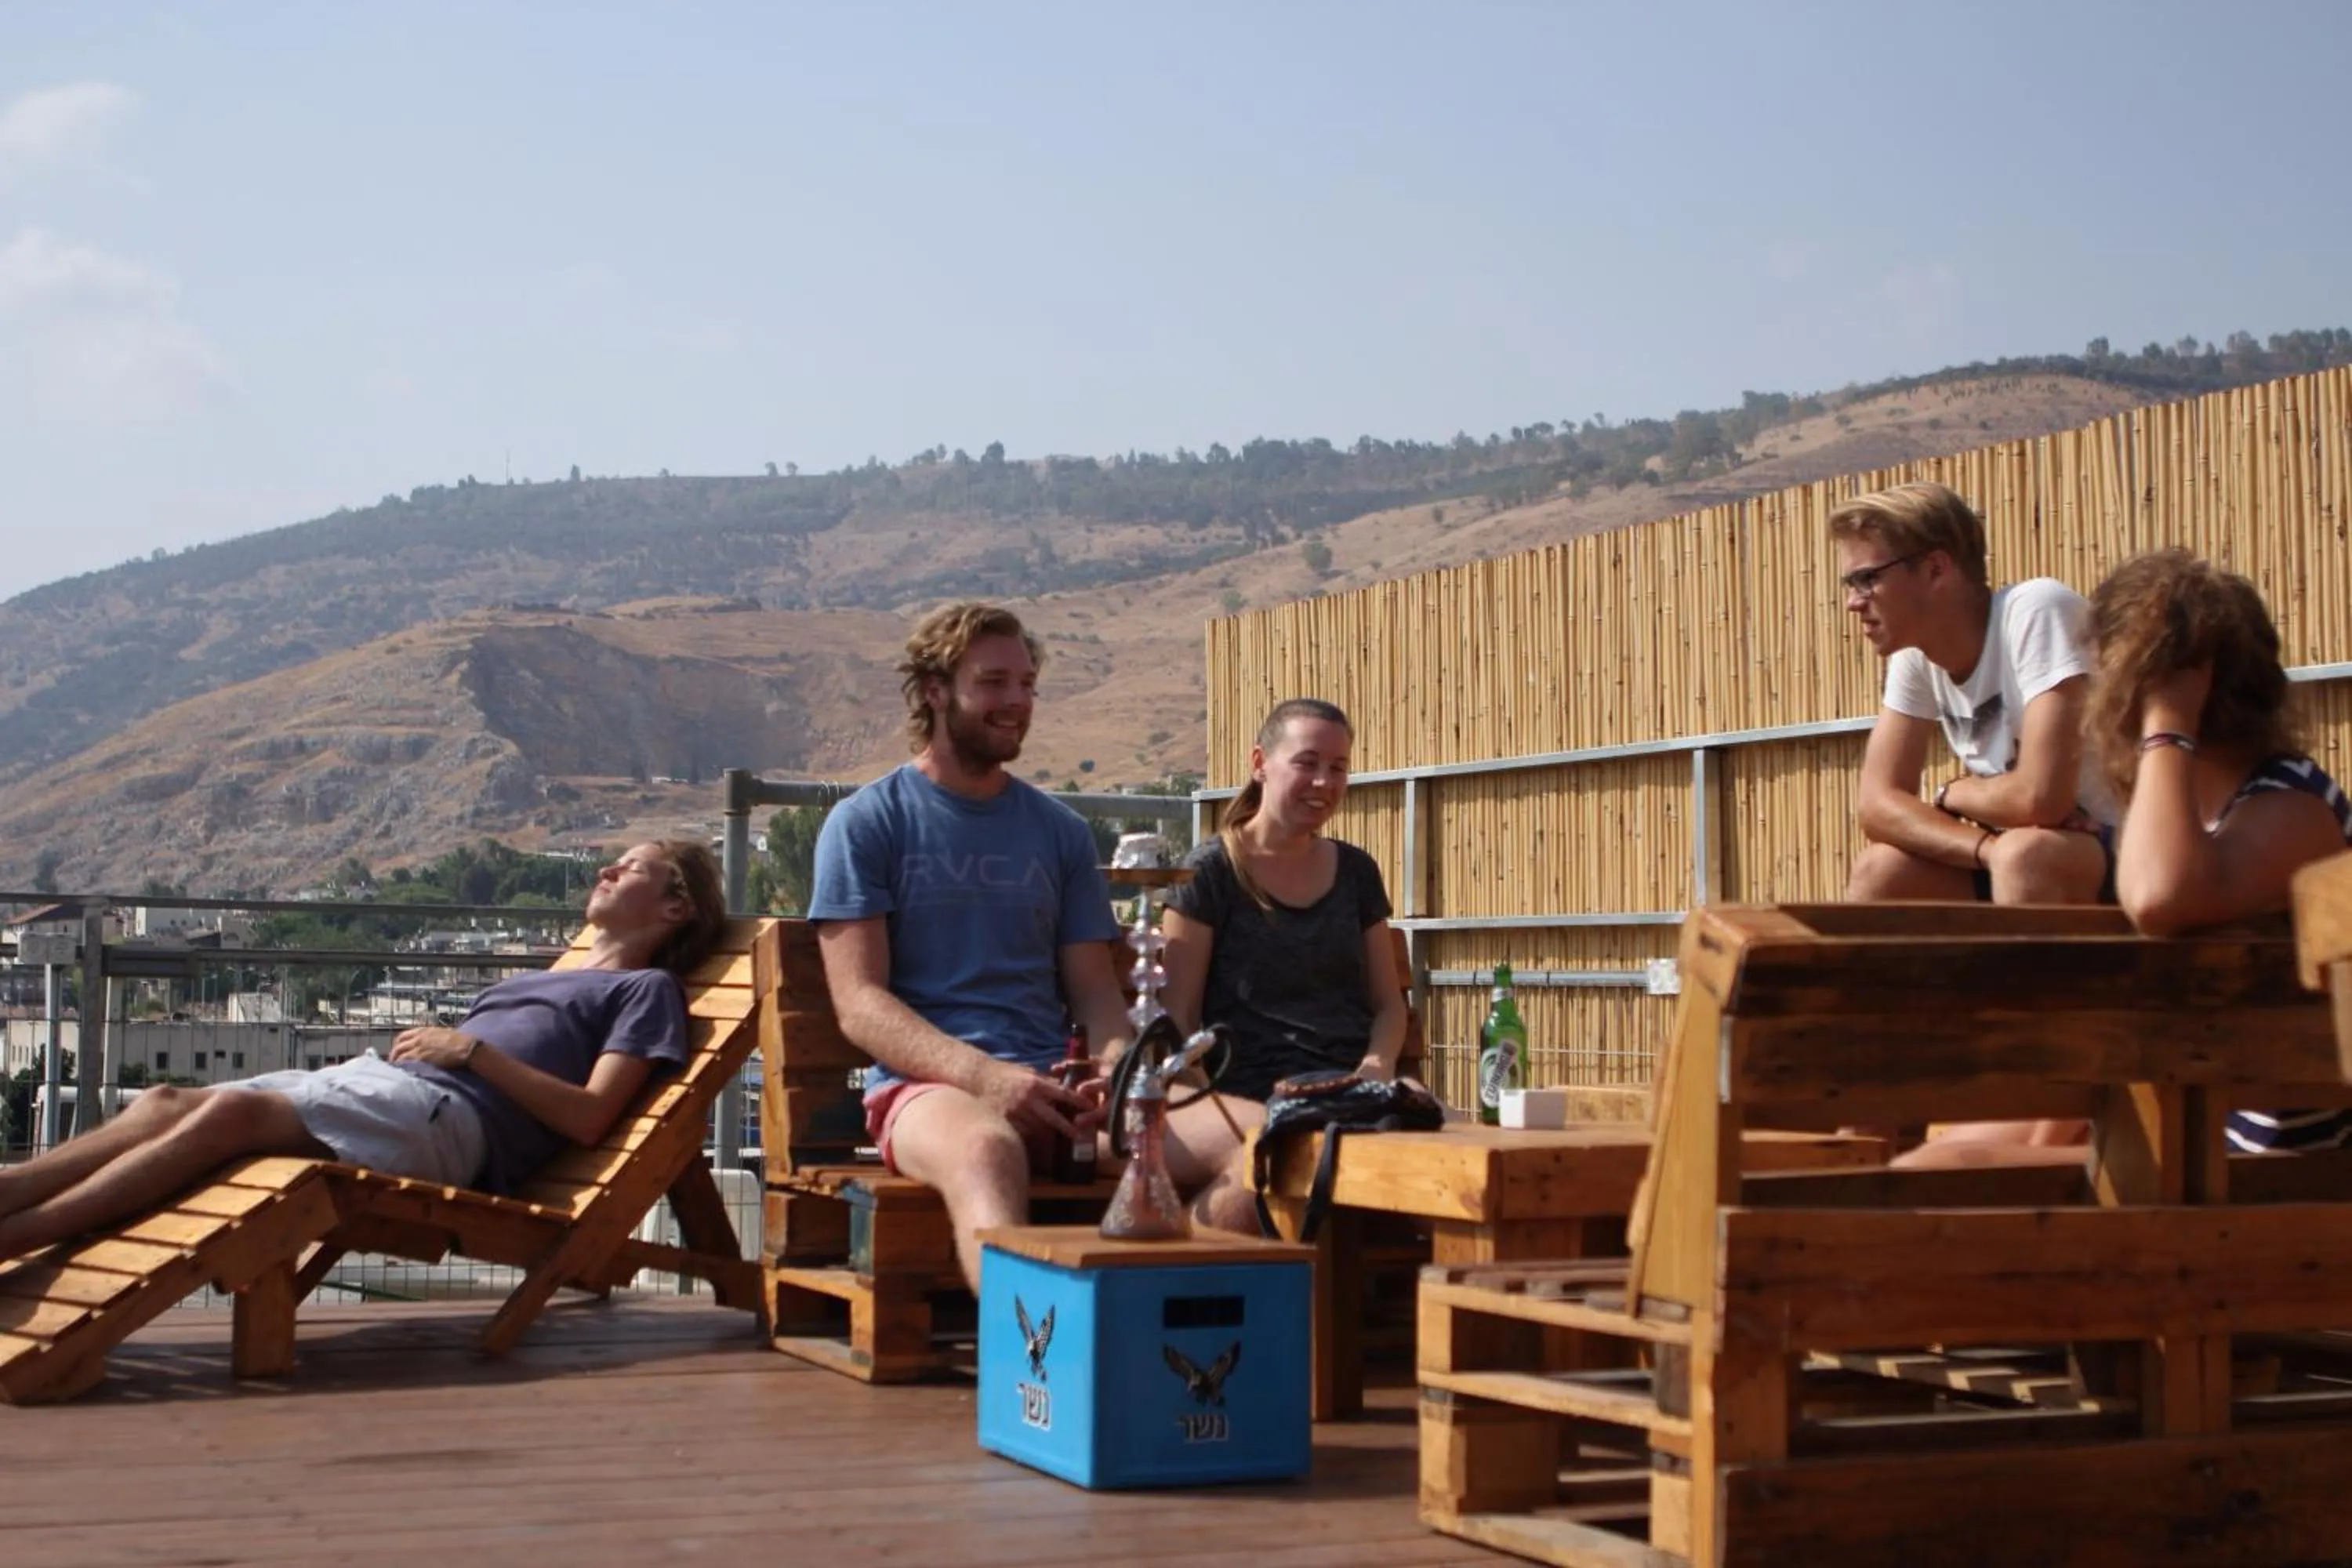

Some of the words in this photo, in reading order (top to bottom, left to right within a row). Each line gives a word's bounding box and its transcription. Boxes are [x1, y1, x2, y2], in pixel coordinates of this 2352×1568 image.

[901, 852, 1054, 893] RVCA
[1016, 1382, 1051, 1431] נשר
[1174, 1414, 1229, 1443] נשר
